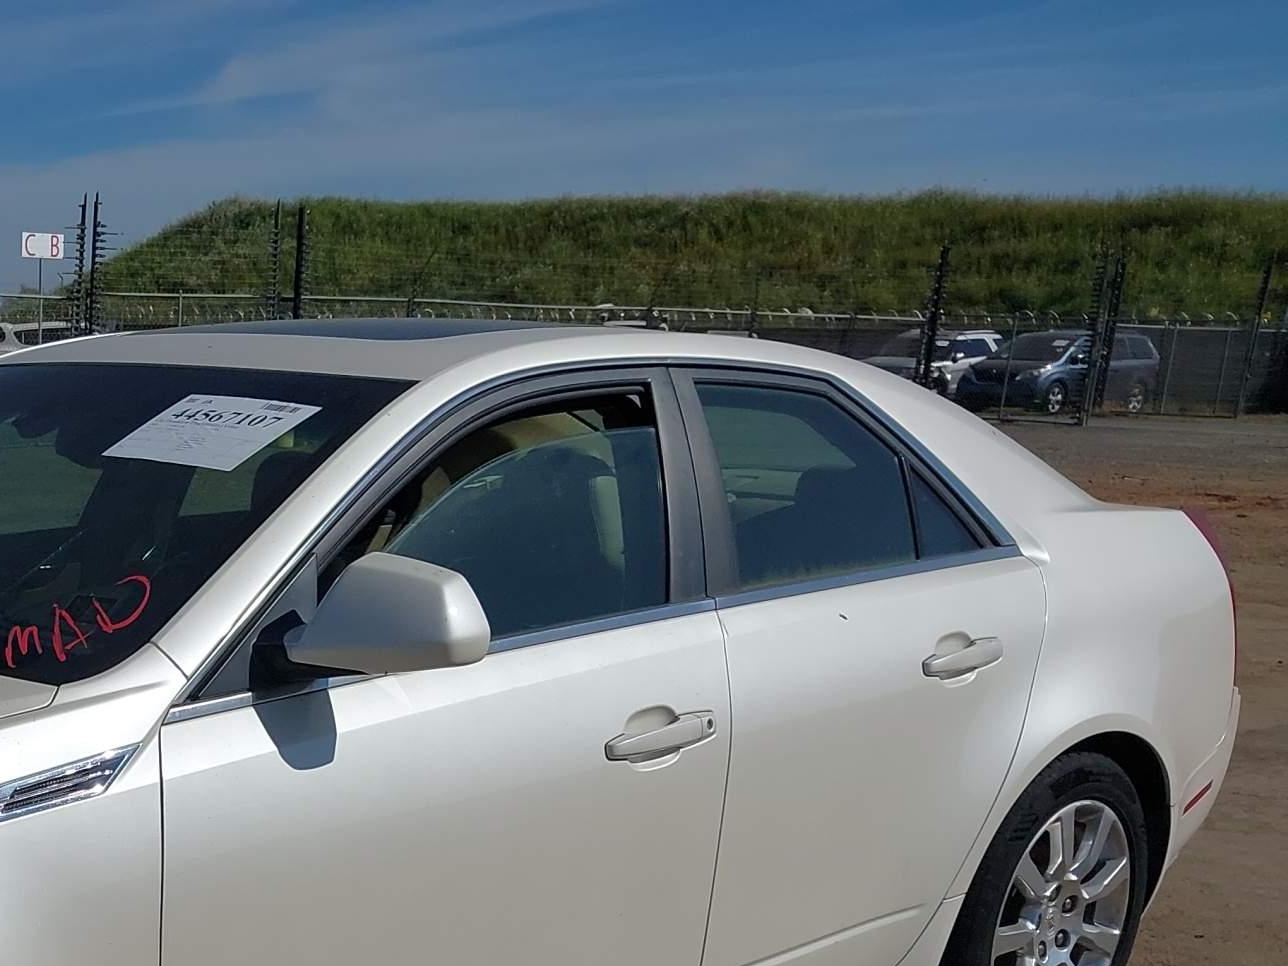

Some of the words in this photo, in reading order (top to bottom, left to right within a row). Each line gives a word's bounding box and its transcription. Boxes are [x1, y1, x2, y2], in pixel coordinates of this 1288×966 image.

[25, 234, 36, 256] C
[51, 235, 60, 257] B
[171, 407, 284, 428] 44567107
